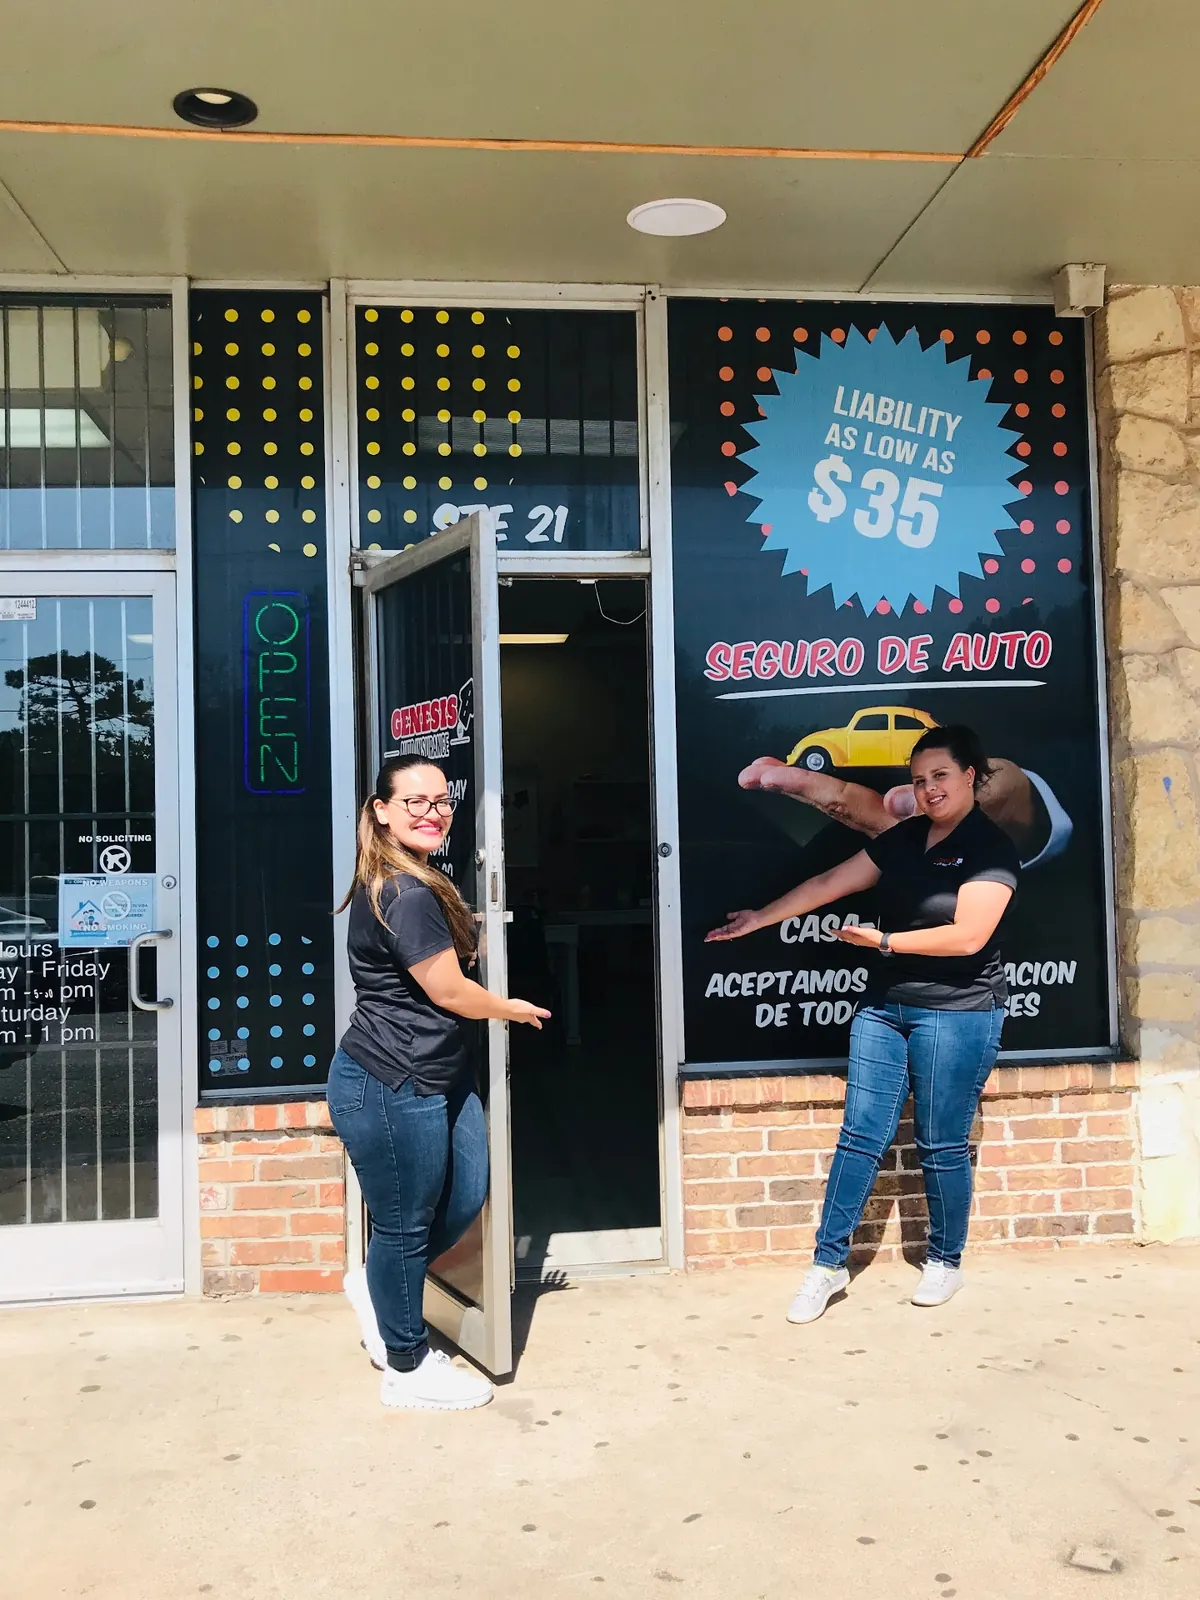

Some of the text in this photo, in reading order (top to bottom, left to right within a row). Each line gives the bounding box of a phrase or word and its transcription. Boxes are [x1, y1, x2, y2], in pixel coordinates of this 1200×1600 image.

[833, 385, 963, 442] LIABILITY
[824, 423, 956, 474] AS LOW AS
[807, 454, 944, 549] $35
[525, 505, 569, 544] 21
[703, 630, 1053, 681] SEGURO DE AUTO
[256, 602, 299, 783] OPEN
[391, 694, 458, 740] GENESIS
[78, 834, 152, 843] NO SOLICITING
[100, 878, 148, 887] WEAPONS
[84, 923, 147, 932] NO SMOKING
[780, 913, 881, 943] CASA-
[42, 959, 111, 981] Friday
[704, 967, 869, 999] ACEPTAMOS
[60, 984, 94, 1003] pm
[755, 1002, 791, 1028] DE
[798, 1000, 859, 1027] TOD
[41, 1025, 49, 1042] 1
[60, 1026, 94, 1046] pm
